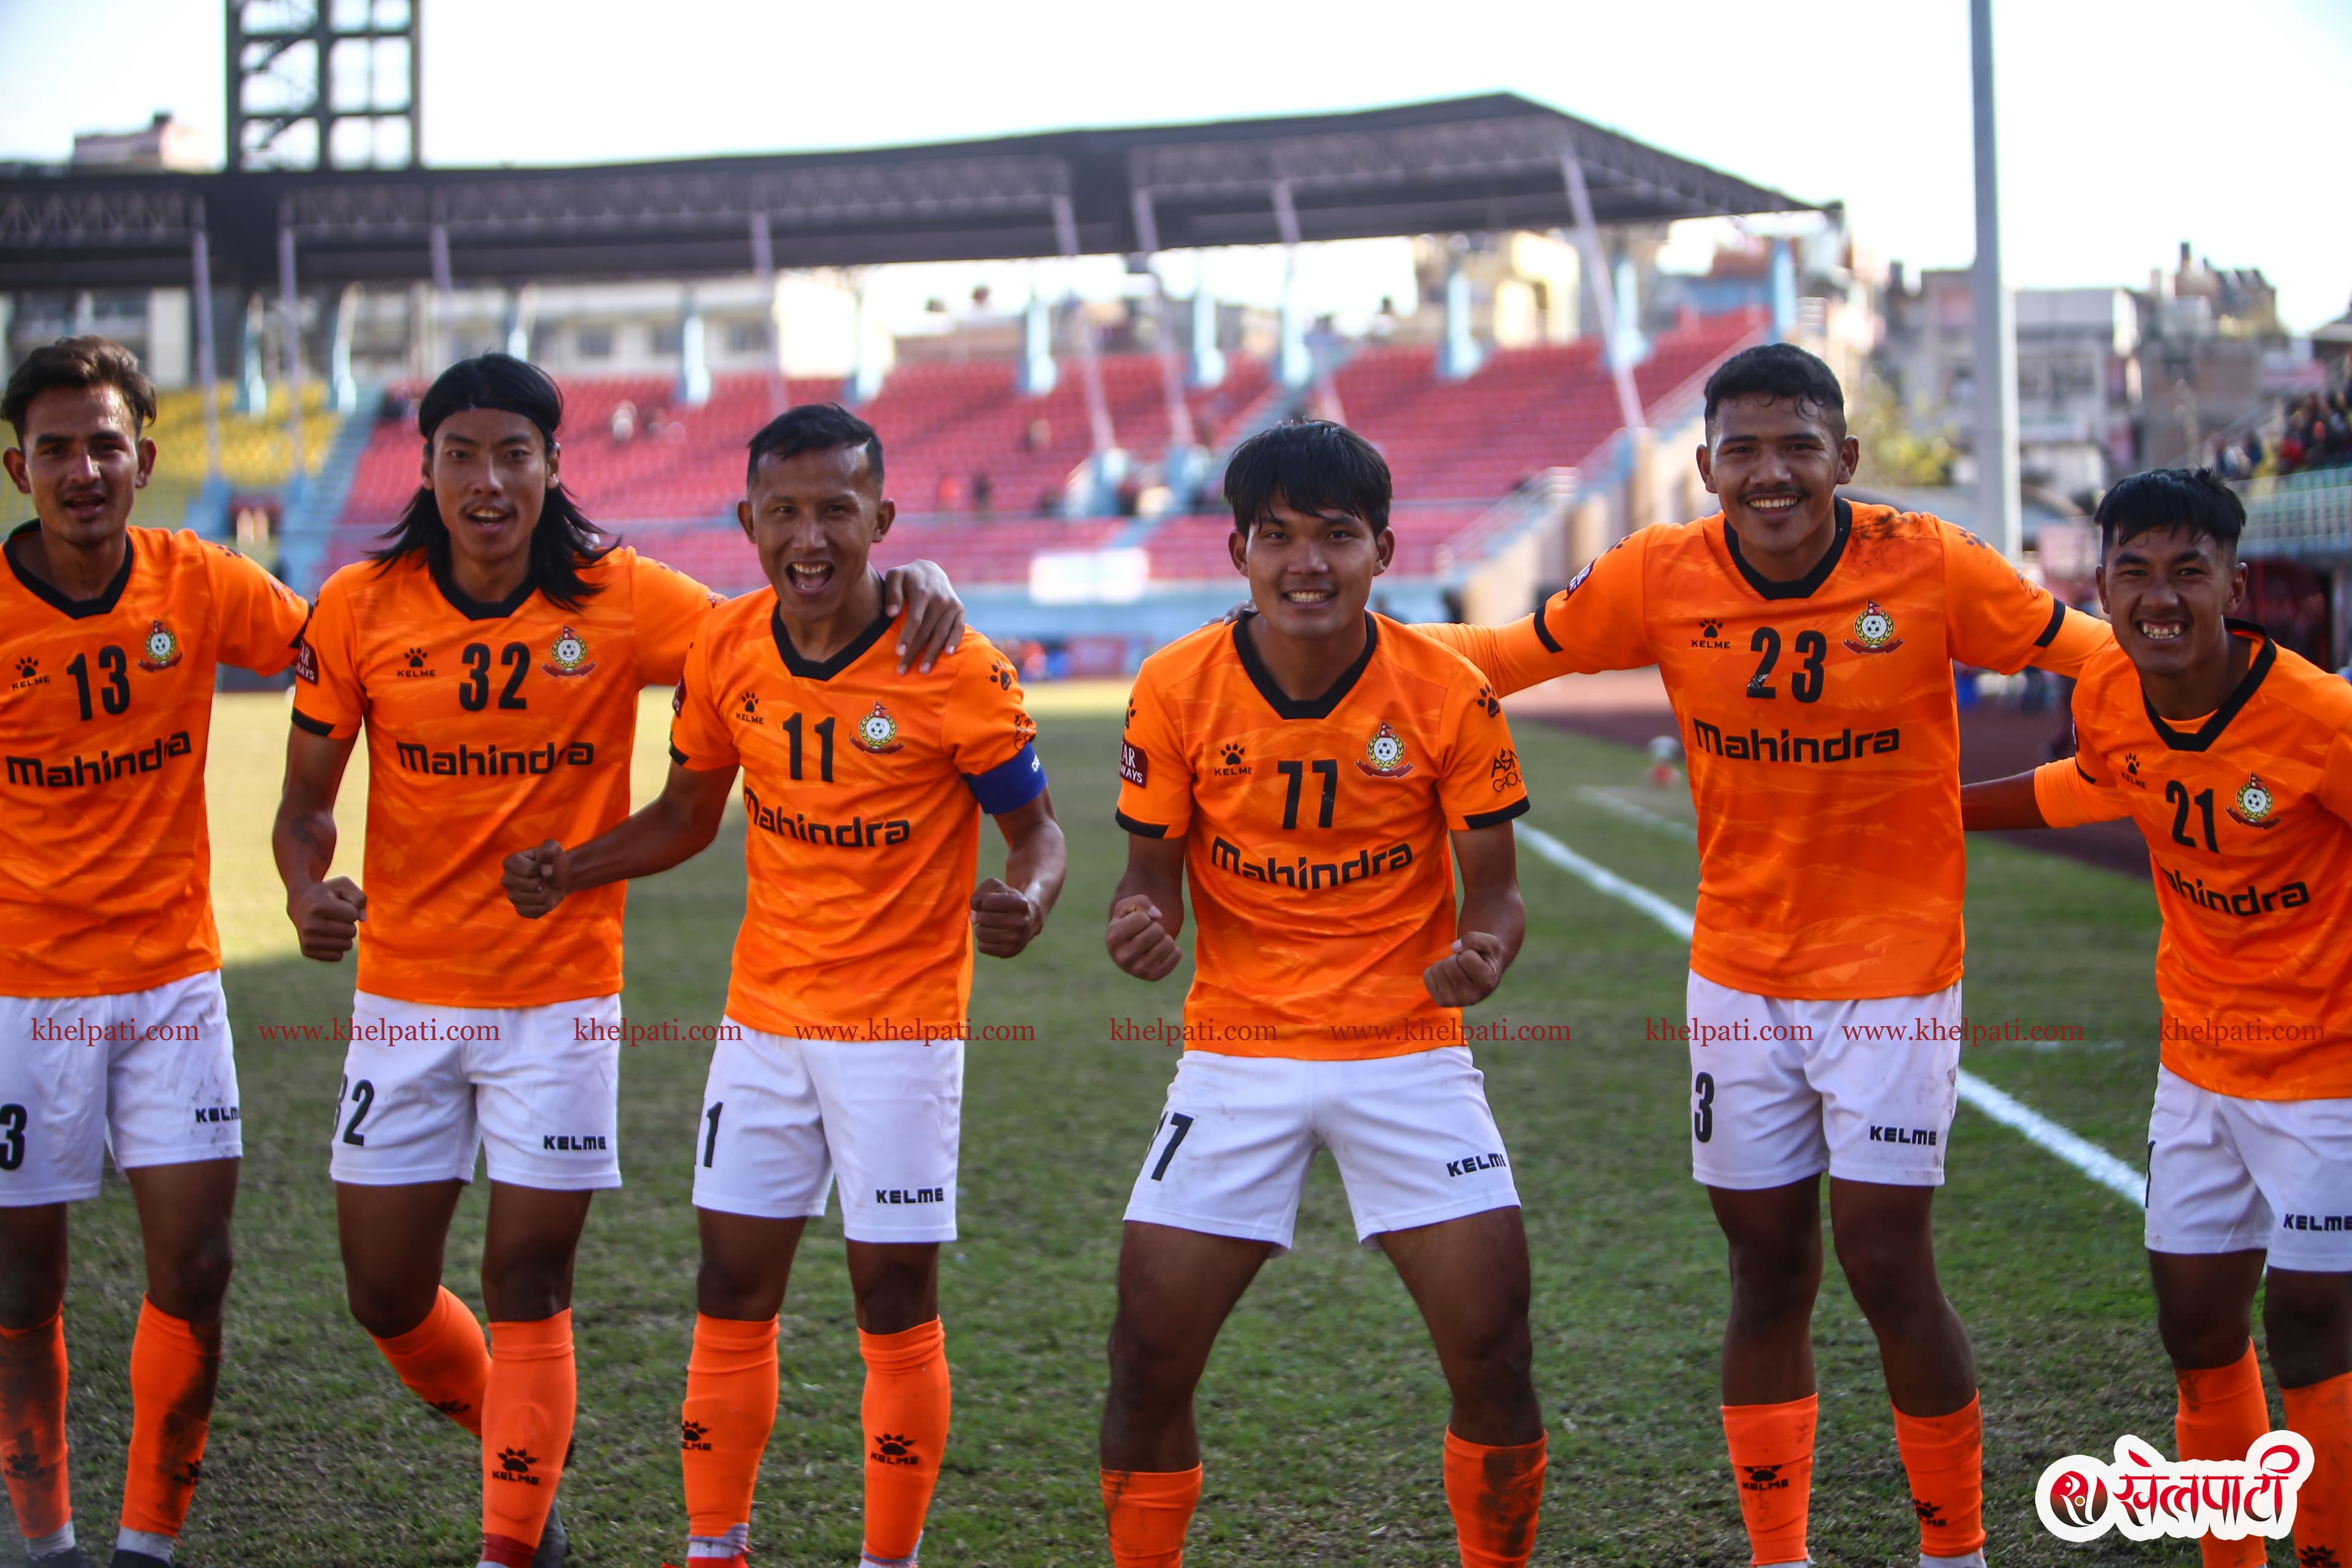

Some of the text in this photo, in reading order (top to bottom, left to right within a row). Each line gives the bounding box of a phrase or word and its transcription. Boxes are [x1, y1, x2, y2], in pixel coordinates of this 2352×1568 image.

[1691, 640, 1730, 649] KELME
[397, 669, 435, 677] KELME
[1747, 627, 1826, 703] 23
[12, 675, 50, 690] KELME
[67, 645, 130, 721] 13
[459, 641, 530, 711] 32
[736, 712, 764, 725] KELME
[782, 712, 835, 782] 11
[1121, 742, 1136, 769] AR
[6, 731, 192, 787] Mahinda
[396, 741, 594, 775] Mahinda
[1214, 767, 1252, 776] KELME
[1278, 759, 1338, 829] 77
[2165, 780, 2219, 853] 21
[195, 1106, 239, 1123] KELM
[544, 1135, 606, 1150] KELME
[1870, 1126, 1936, 1146] KELME
[1143, 1110, 1194, 1182] 7
[1446, 1153, 1507, 1177] KELM
[876, 1187, 943, 1204] KELME
[2283, 1213, 2352, 1232] KELME
[870, 1452, 918, 1465] KELME
[492, 1469, 539, 1485] KELME
[1742, 1479, 1789, 1491] KELME
